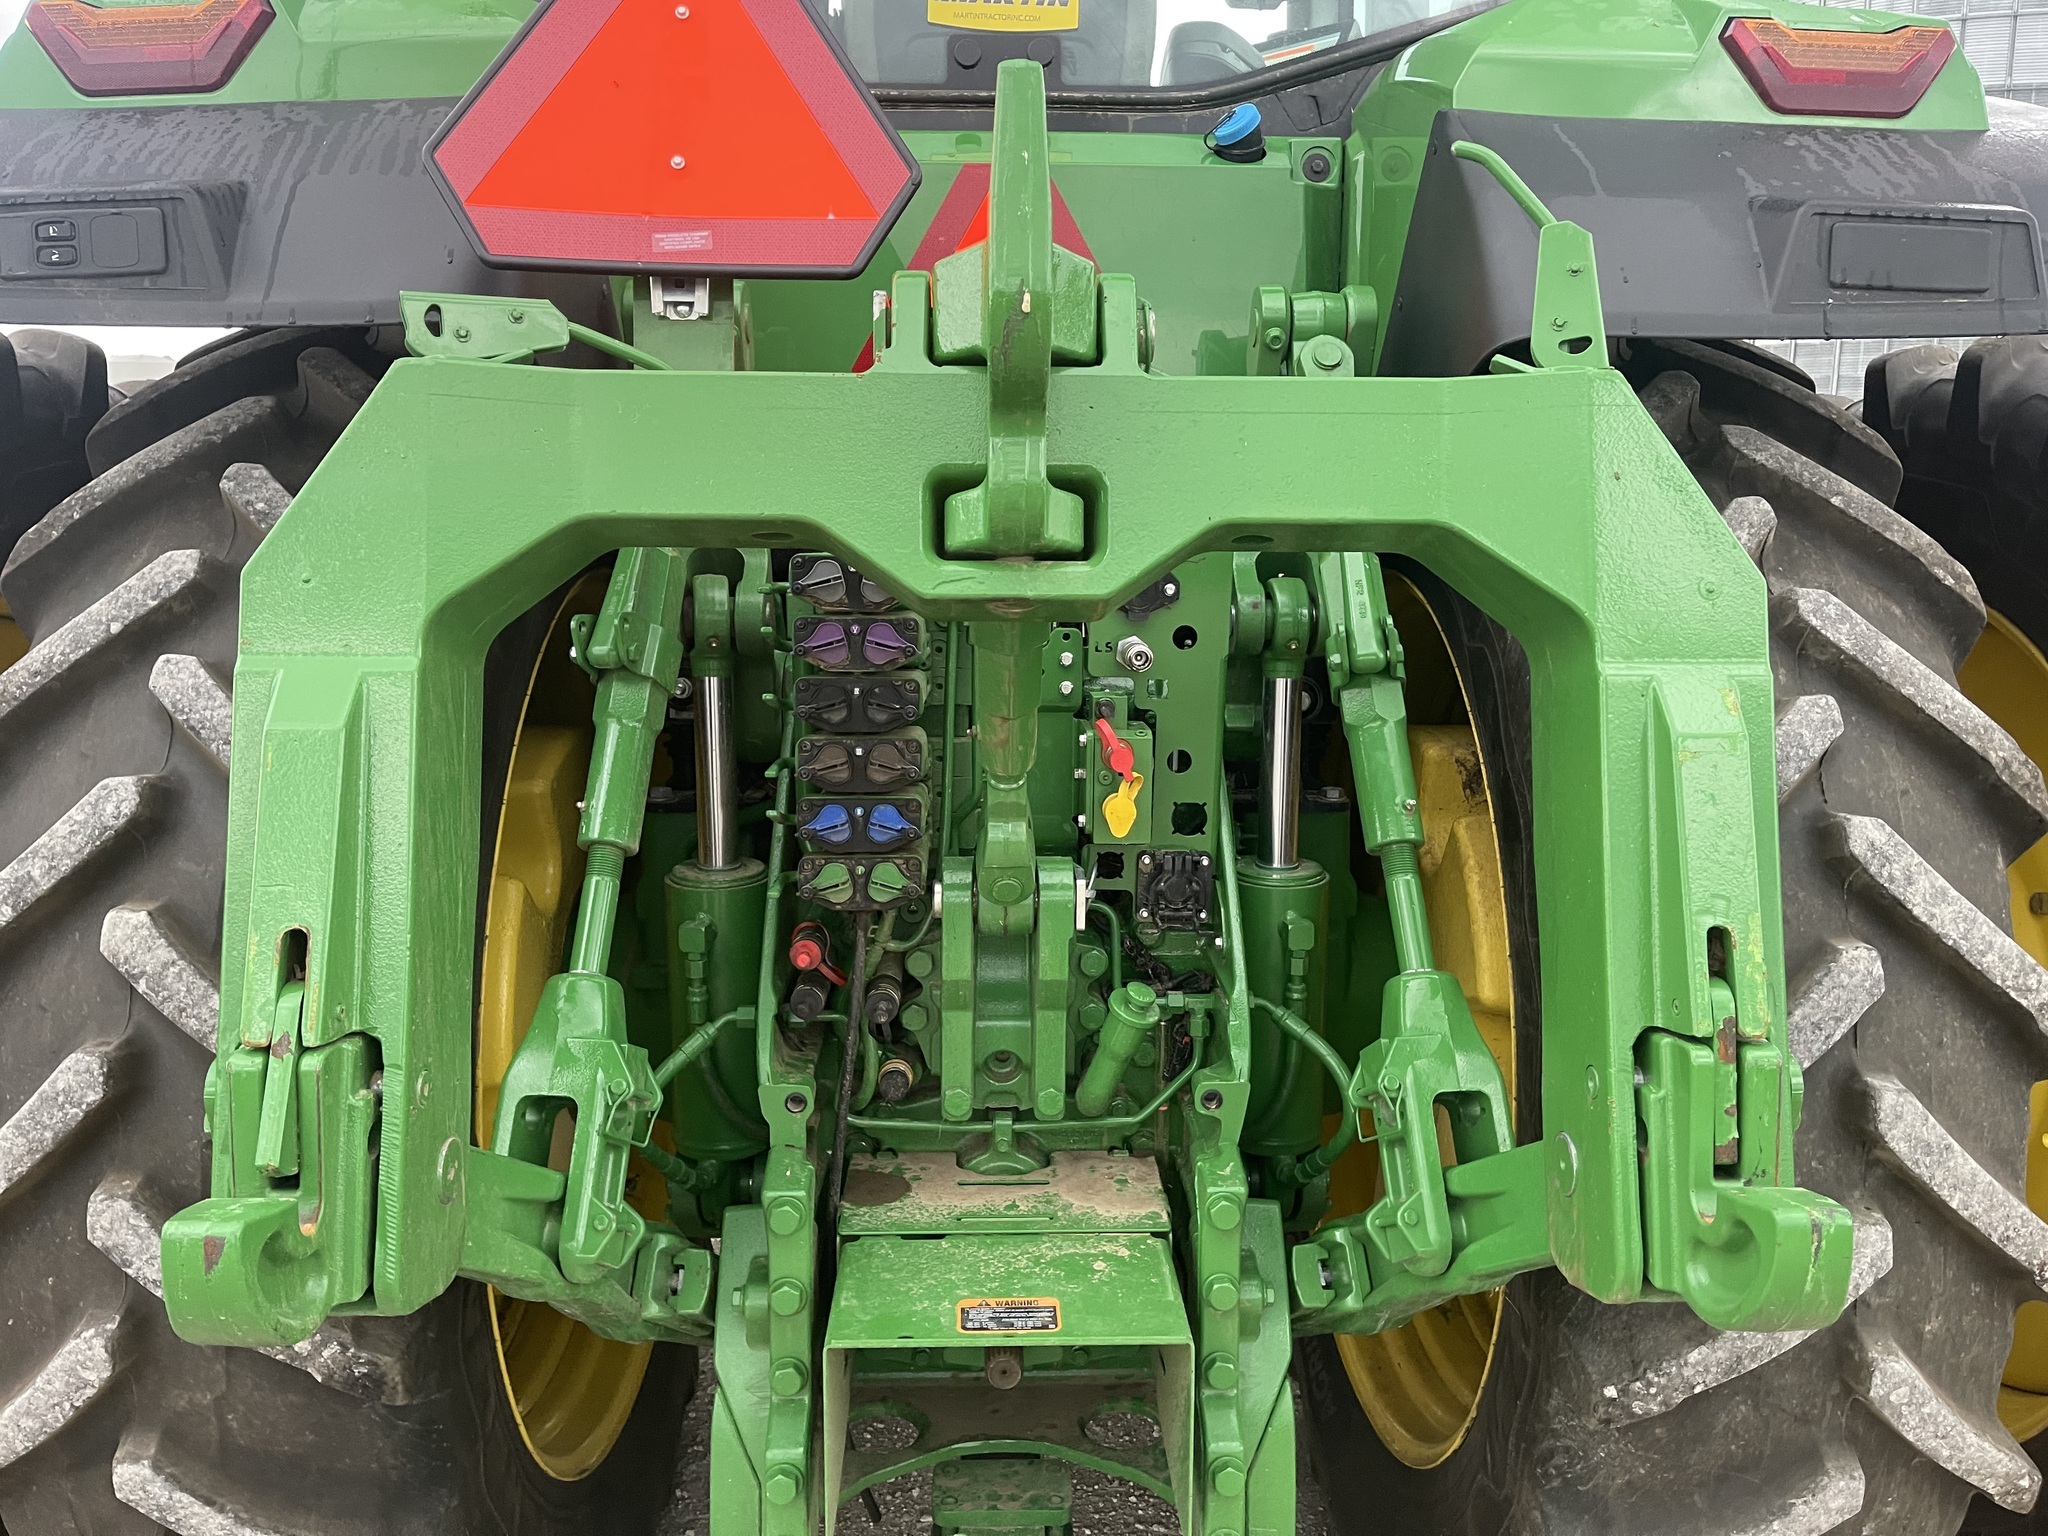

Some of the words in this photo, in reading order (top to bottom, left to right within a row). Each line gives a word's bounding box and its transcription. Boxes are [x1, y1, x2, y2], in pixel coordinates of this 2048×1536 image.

[953, 12, 1041, 22] MARTINTRACTORINC.COM
[1095, 641, 1113, 653] LS
[995, 1299, 1039, 1307] WARNING
